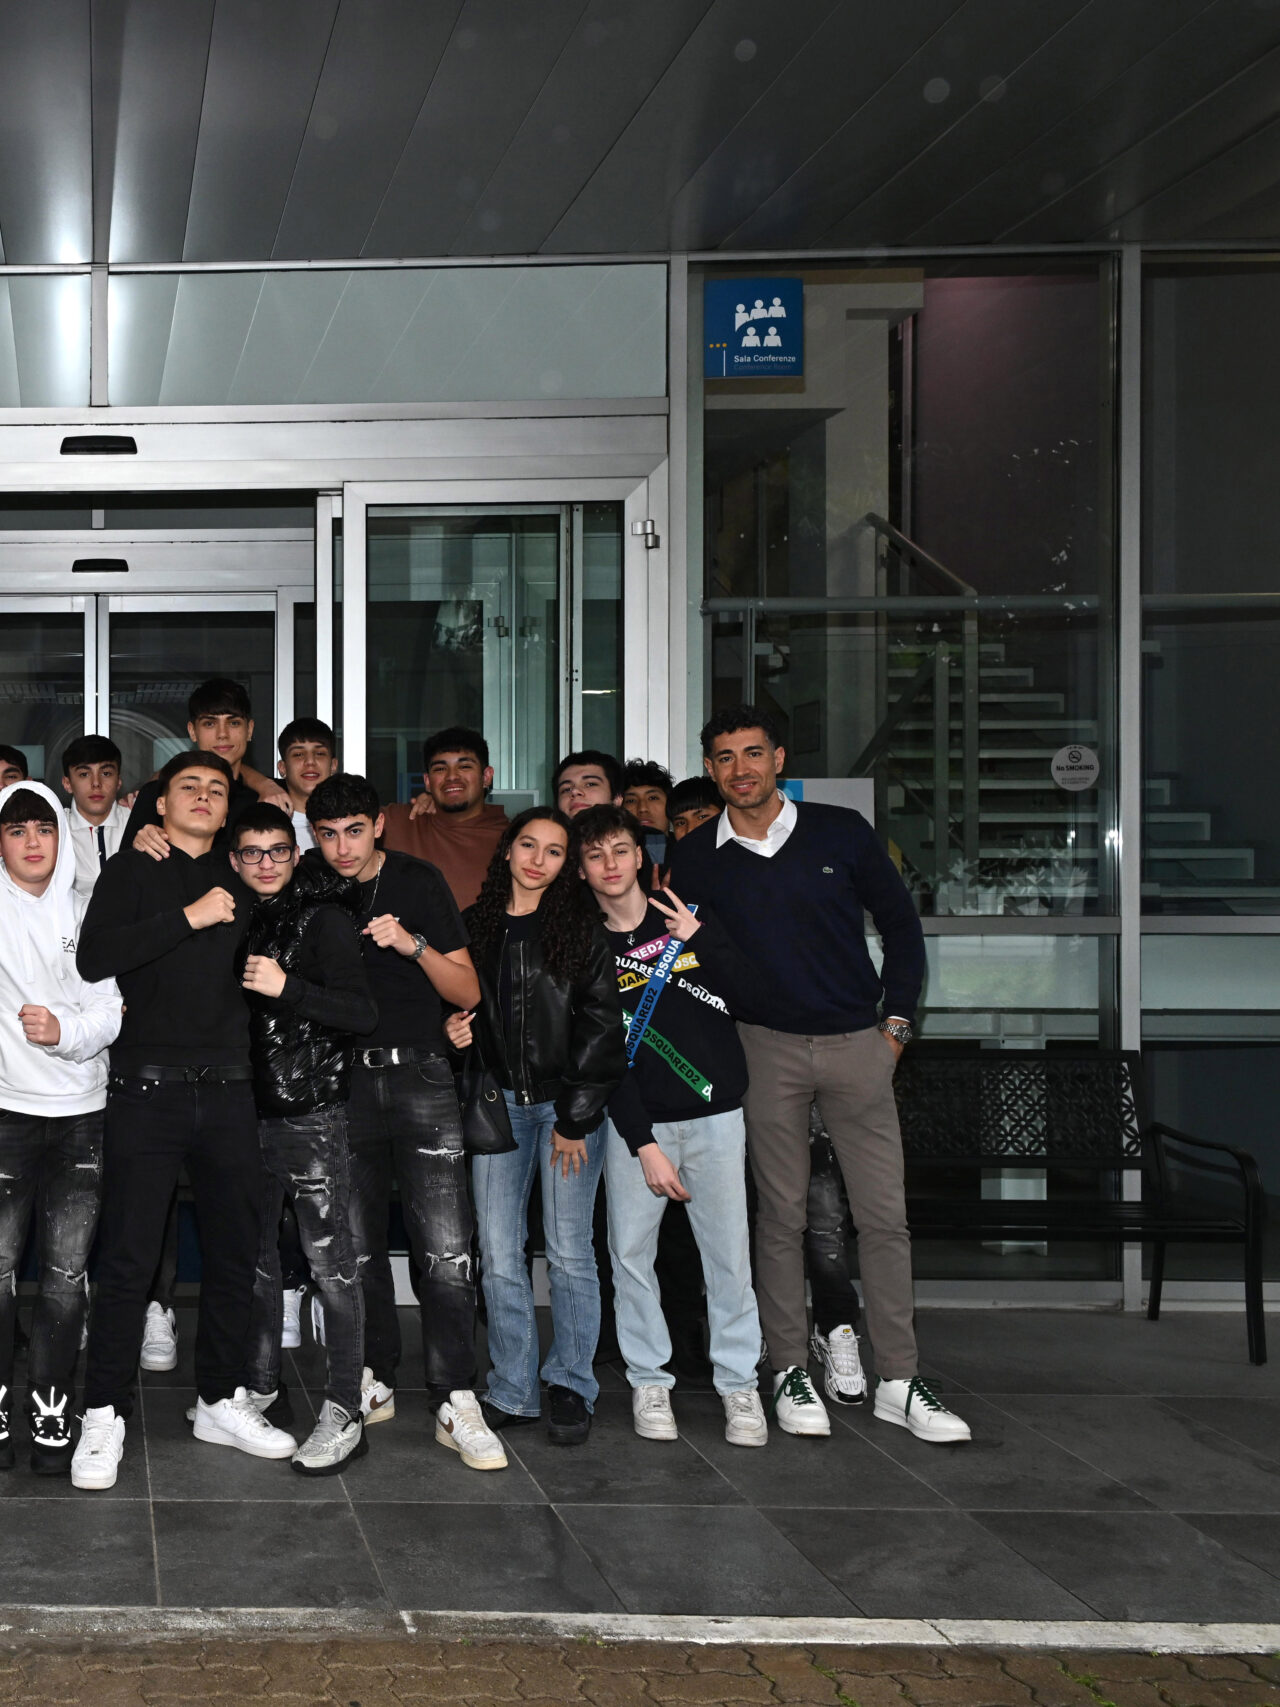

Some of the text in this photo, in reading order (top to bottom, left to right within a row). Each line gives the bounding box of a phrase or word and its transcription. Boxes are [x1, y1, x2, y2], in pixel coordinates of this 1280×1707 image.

[734, 354, 796, 363] Sala Conferenze
[642, 1029, 700, 1085] DSQUARED2
